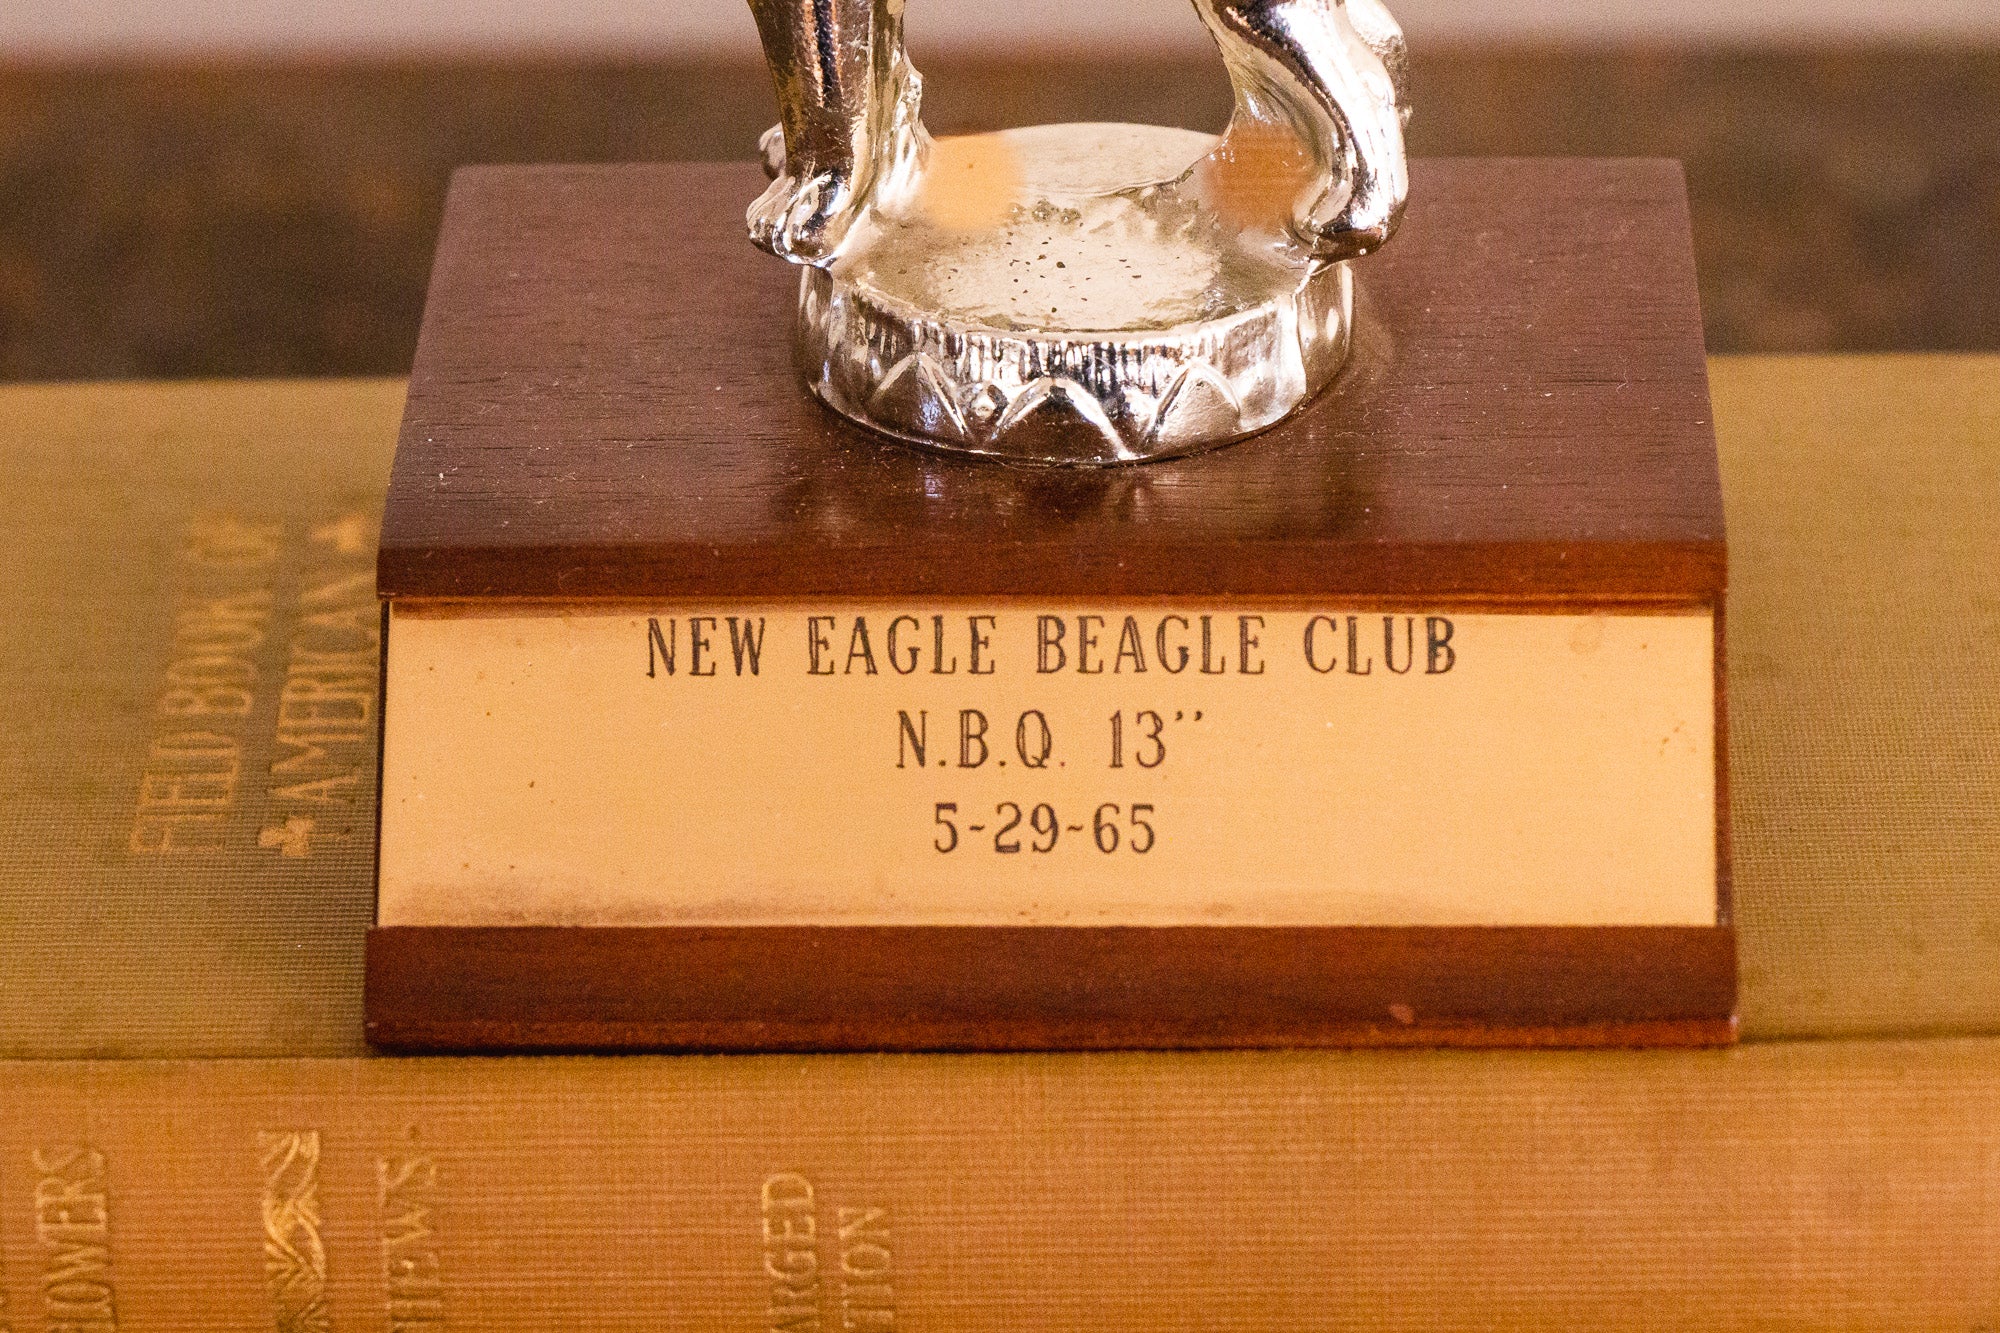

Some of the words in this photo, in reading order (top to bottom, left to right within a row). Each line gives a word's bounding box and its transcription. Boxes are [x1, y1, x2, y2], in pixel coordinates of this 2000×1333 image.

[646, 616, 766, 678] NEW
[806, 614, 997, 676] EAGLE
[1035, 614, 1266, 675] BEAGLE
[1303, 614, 1457, 676] CLUB
[896, 708, 1066, 769] N.B.Q.
[129, 731, 241, 853] FIELD
[934, 802, 1156, 854] 5-29-65
